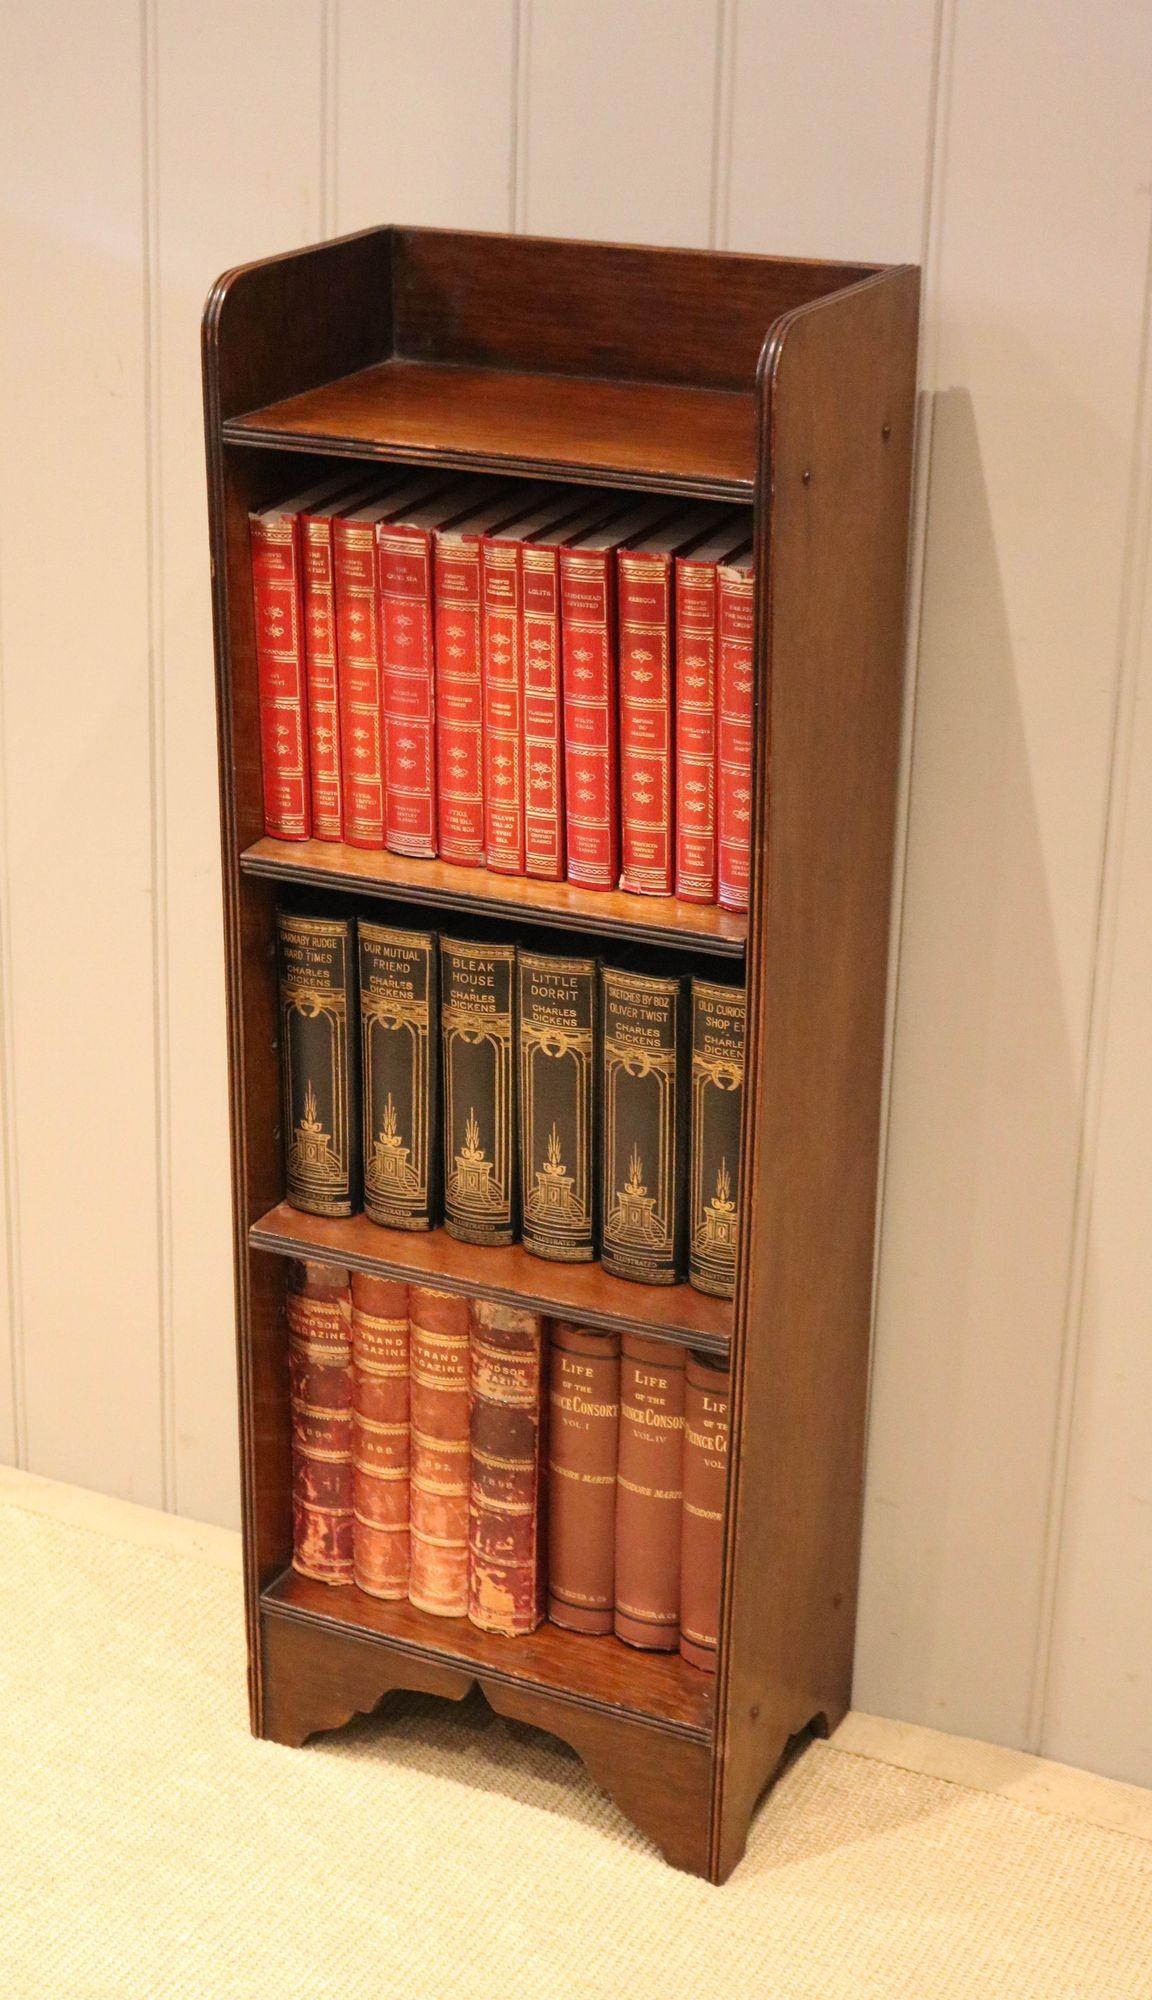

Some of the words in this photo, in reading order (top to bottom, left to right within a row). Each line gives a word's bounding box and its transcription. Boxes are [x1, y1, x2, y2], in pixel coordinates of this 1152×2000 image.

[527, 588, 551, 597] LOLITA
[312, 936, 338, 949] RUDGE
[306, 951, 333, 964] TIMES
[364, 942, 382, 957] OUR
[383, 946, 421, 962] MUTUAL
[287, 964, 331, 979] CHARLES
[373, 958, 411, 974] FRIEND
[452, 957, 495, 973] BLEAK
[287, 973, 331, 988] DICKENS
[369, 975, 414, 991] CHARLES
[452, 971, 495, 987] HOUSE
[532, 973, 578, 988] LITTLE
[369, 984, 414, 1000] DICKENS
[450, 990, 496, 1004] CHARLES
[531, 985, 579, 1001] DORRIT
[608, 987, 641, 1004] SKETCHES
[642, 994, 652, 1006] BY
[653, 995, 670, 1008] BOZ
[450, 999, 496, 1013] DICKENS
[532, 1004, 577, 1017] CHARLES
[609, 1002, 638, 1019] OLIVER
[639, 1009, 668, 1023] TWIST
[699, 1000, 714, 1013] OLD
[532, 1012, 578, 1027] DICKENS
[706, 1016, 730, 1031] SHOP
[615, 1022, 661, 1038] CHARLES
[615, 1031, 661, 1047] DICKENS
[453, 1217, 496, 1232] ILLUSTRATED
[533, 1233, 577, 1248] ILLUSTRATED
[613, 1254, 658, 1269] ILLUSTRATED
[562, 1358, 594, 1378] LIFE
[562, 1381, 573, 1390] OF
[574, 1384, 592, 1394] THE
[634, 1370, 669, 1390] LIFE
[635, 1392, 646, 1401] OF
[647, 1396, 666, 1406] THE
[703, 1420, 715, 1428] OF
